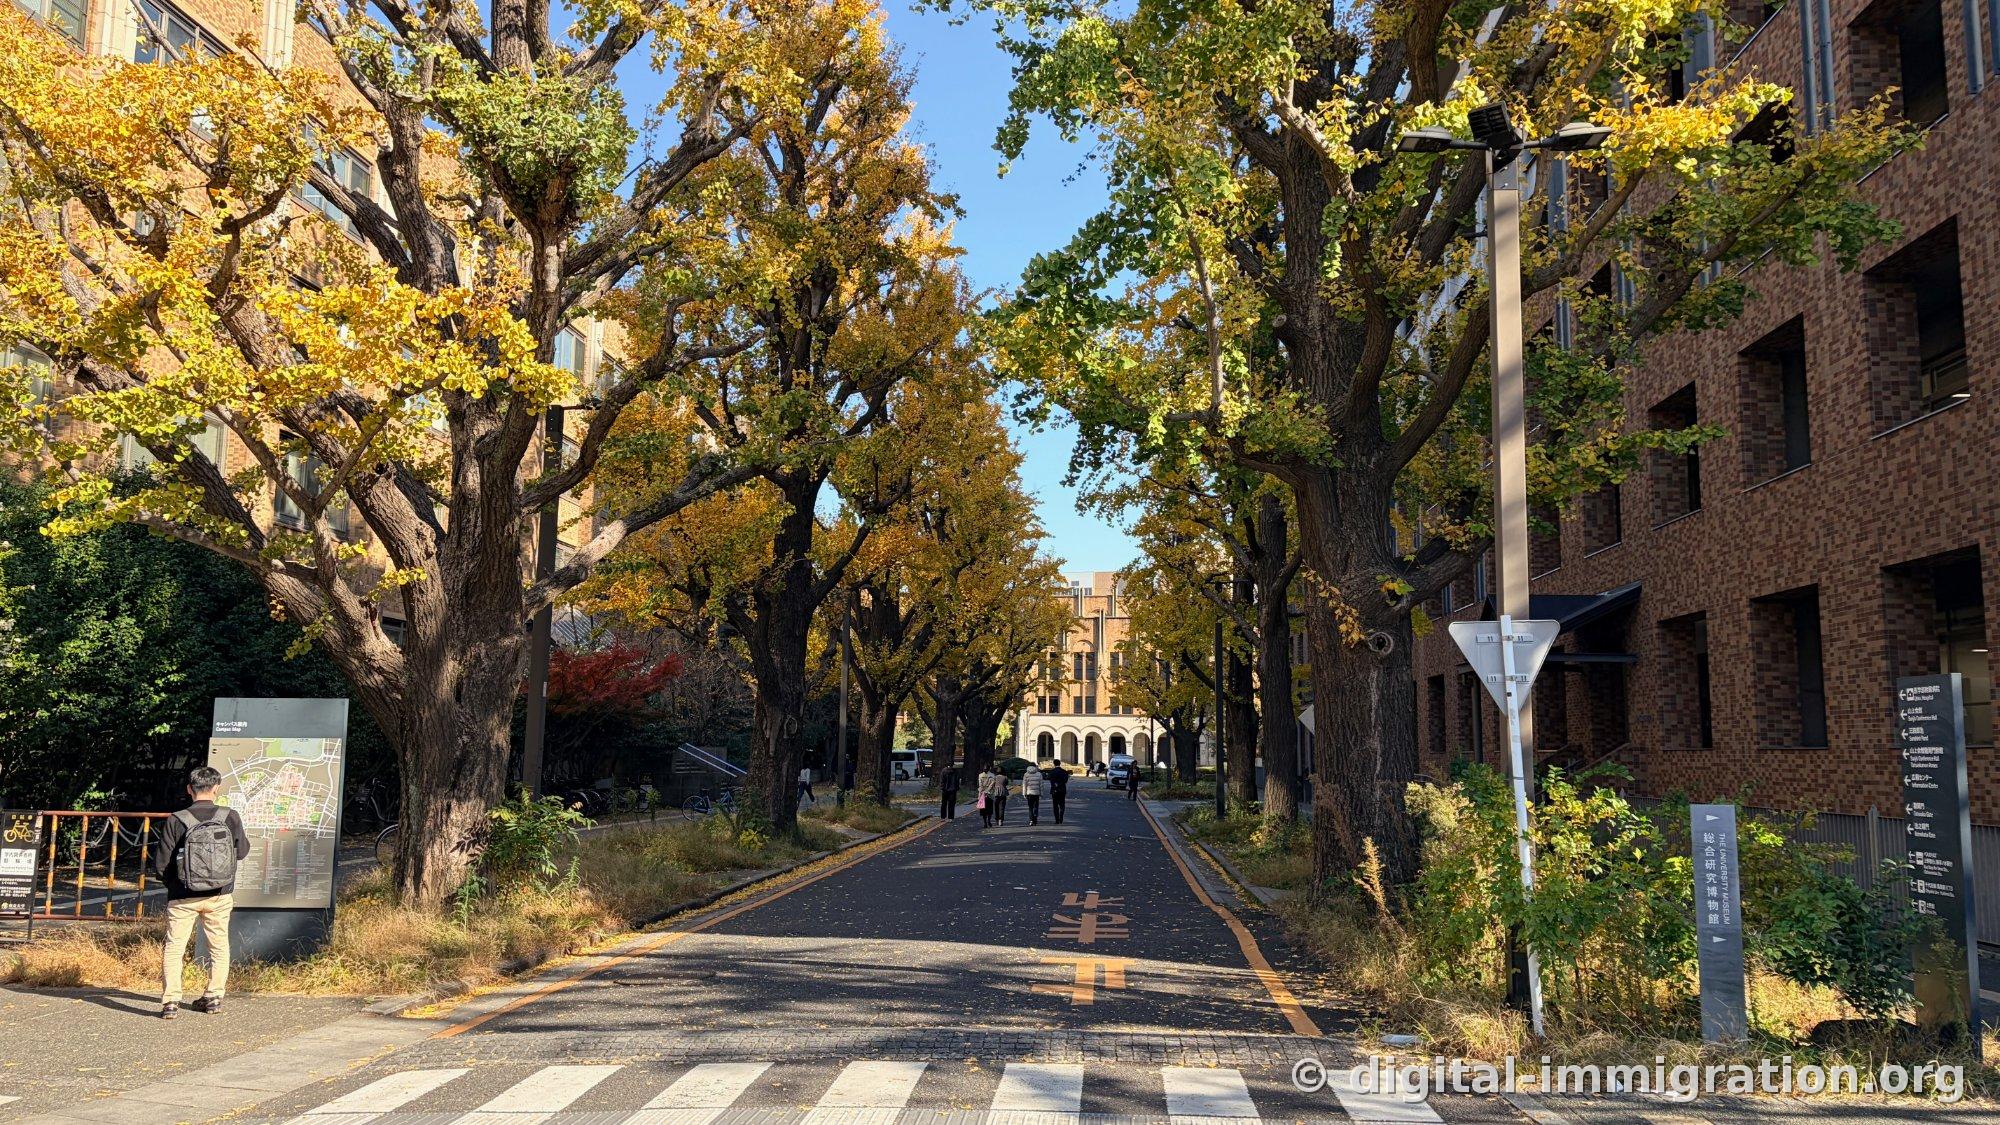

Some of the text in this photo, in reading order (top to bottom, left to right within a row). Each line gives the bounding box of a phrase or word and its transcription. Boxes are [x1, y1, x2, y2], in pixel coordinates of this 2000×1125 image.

[1703, 832, 1720, 924] 総合研究博物館
[1719, 832, 1730, 925] THE UNIVERSITY MUSEUM
